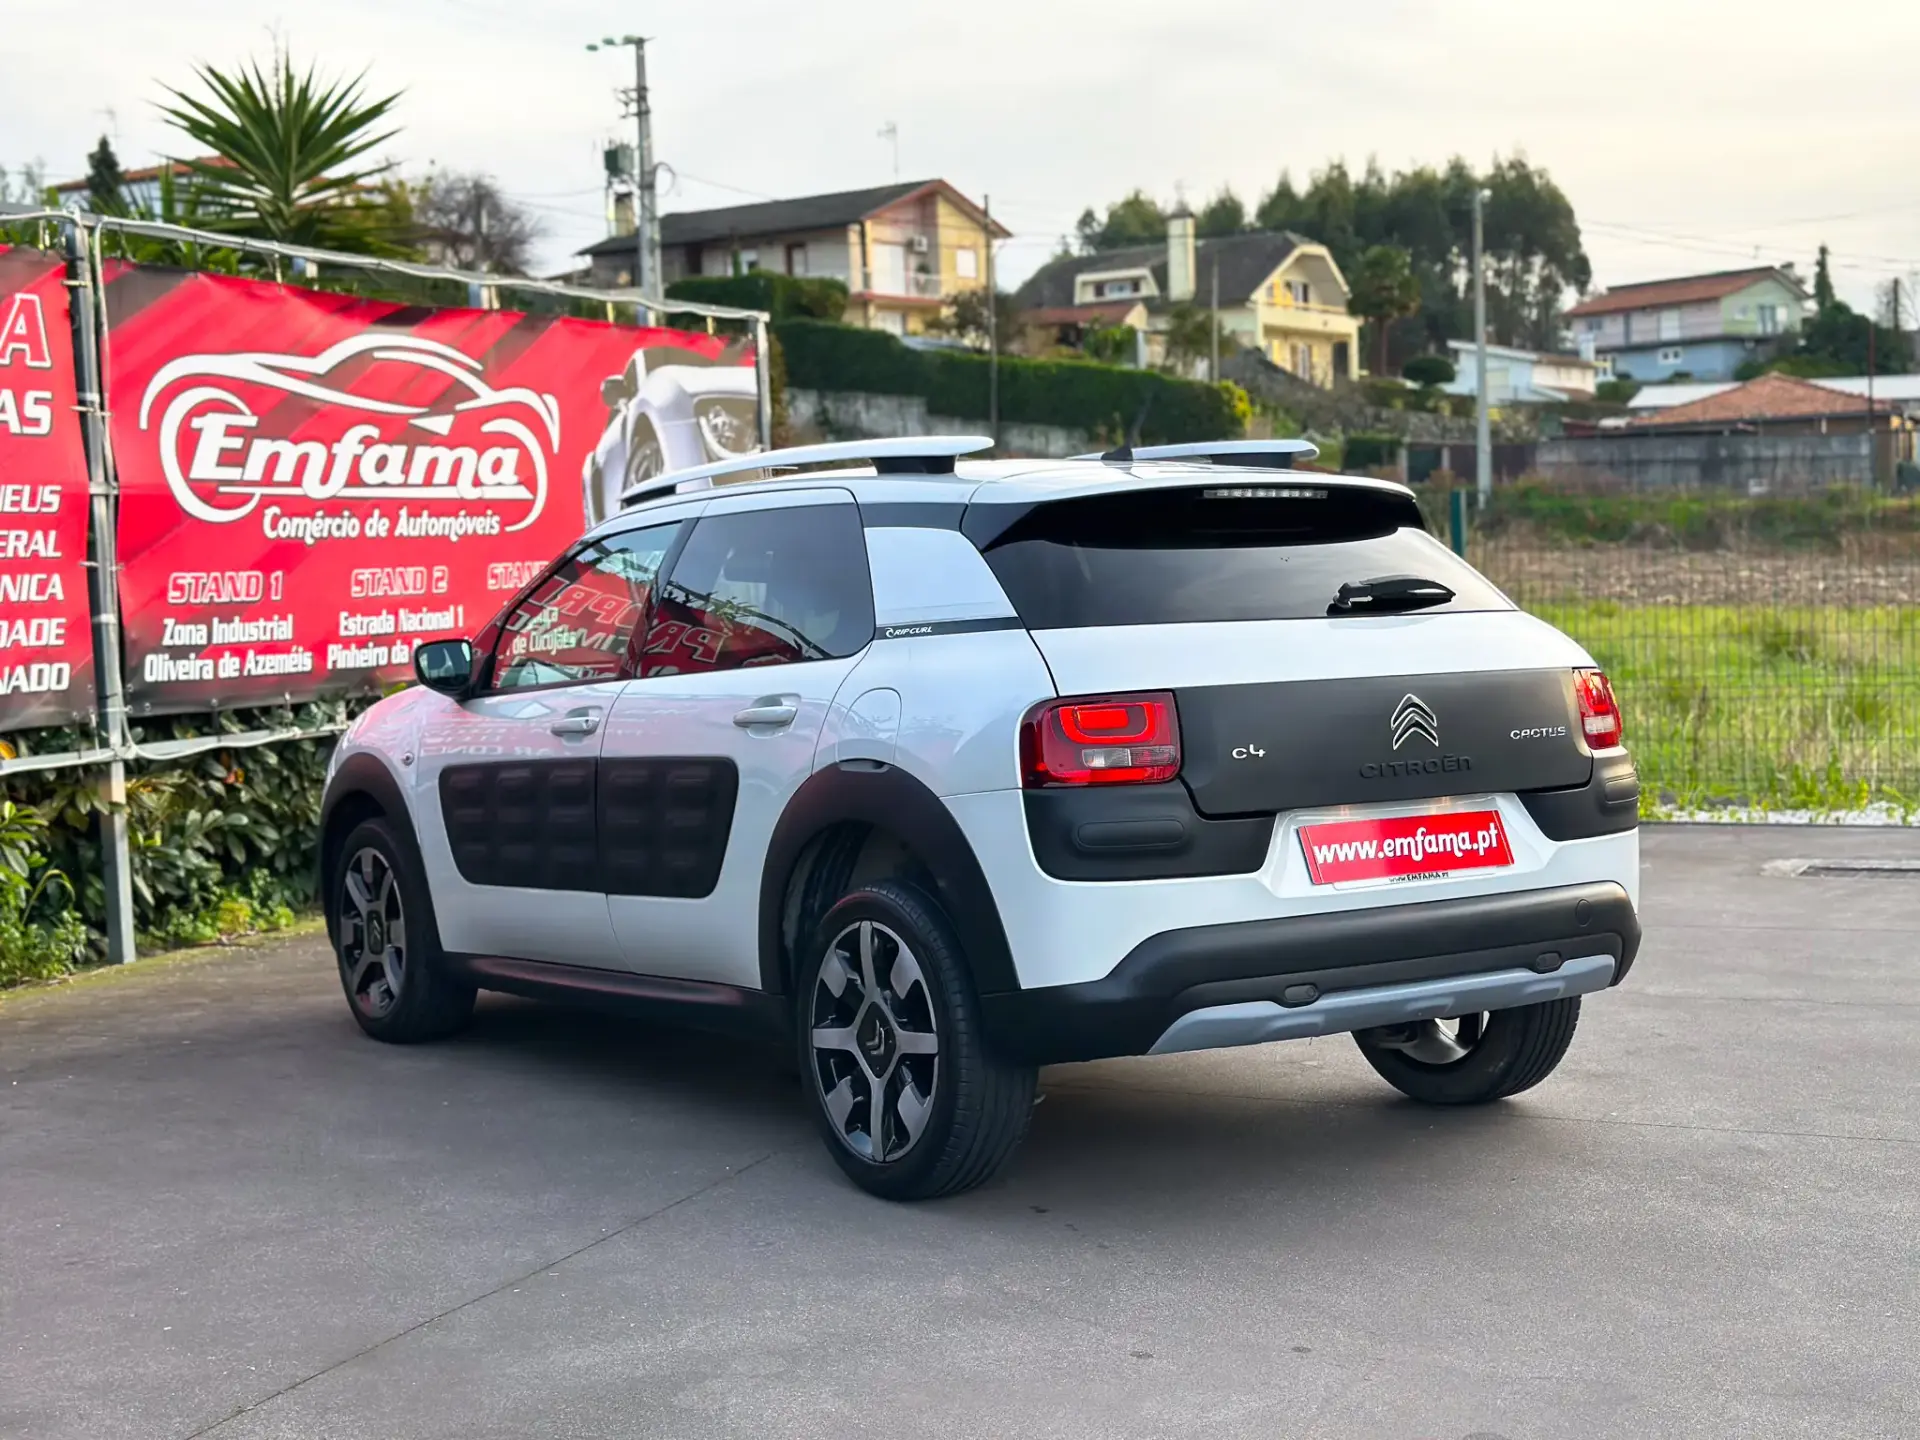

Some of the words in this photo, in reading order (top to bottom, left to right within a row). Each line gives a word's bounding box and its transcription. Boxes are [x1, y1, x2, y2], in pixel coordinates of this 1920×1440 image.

[0, 388, 53, 435] AS
[189, 411, 520, 500] Emfama
[0, 484, 62, 513] EUS
[263, 505, 360, 546] Comércio
[364, 508, 390, 538] de
[394, 505, 501, 543] Automóveis
[168, 572, 263, 604] STAND
[270, 570, 284, 601] 1
[351, 567, 426, 598] STAND
[432, 565, 448, 594] 2
[162, 618, 208, 646] Zona
[212, 614, 294, 645] Industrial
[339, 609, 395, 637] Estrada
[398, 605, 454, 633] Nacional
[456, 604, 464, 628] 1
[326, 643, 388, 670] Pinheiro
[391, 641, 410, 665] da
[512, 634, 527, 656] de
[144, 652, 214, 682] Oliveira
[218, 651, 240, 679] de
[244, 645, 313, 677] Azeméis
[1510, 726, 1566, 740] CACTUS
[1313, 822, 1499, 864] www.emfama.pt
